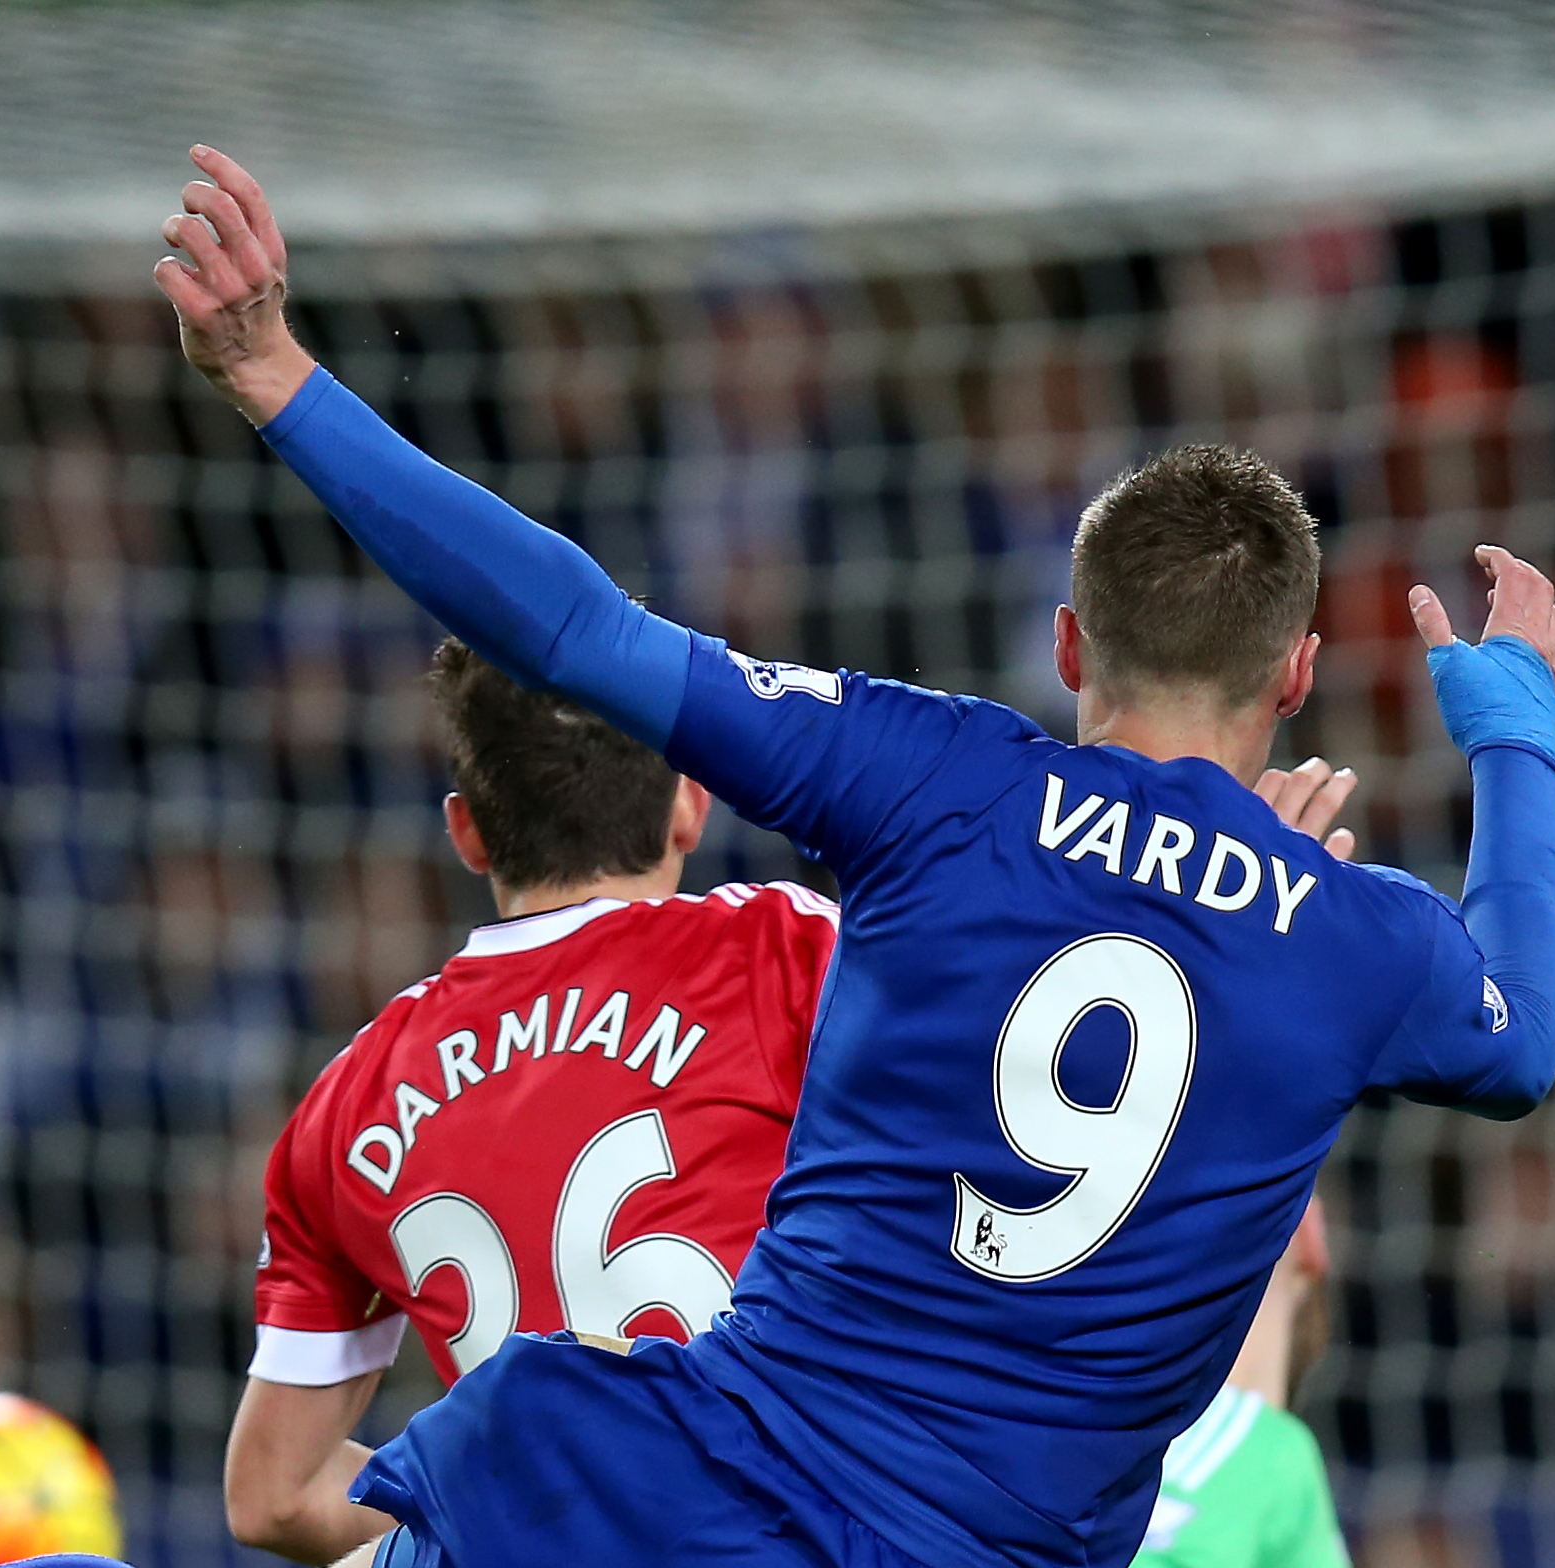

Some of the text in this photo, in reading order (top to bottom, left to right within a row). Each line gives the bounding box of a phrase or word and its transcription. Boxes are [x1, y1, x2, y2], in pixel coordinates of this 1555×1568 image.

[1036, 771, 1317, 935] VARDY
[346, 987, 707, 1196] DARMIAN
[950, 932, 1198, 1283] 9
[389, 1108, 737, 1376] 26
